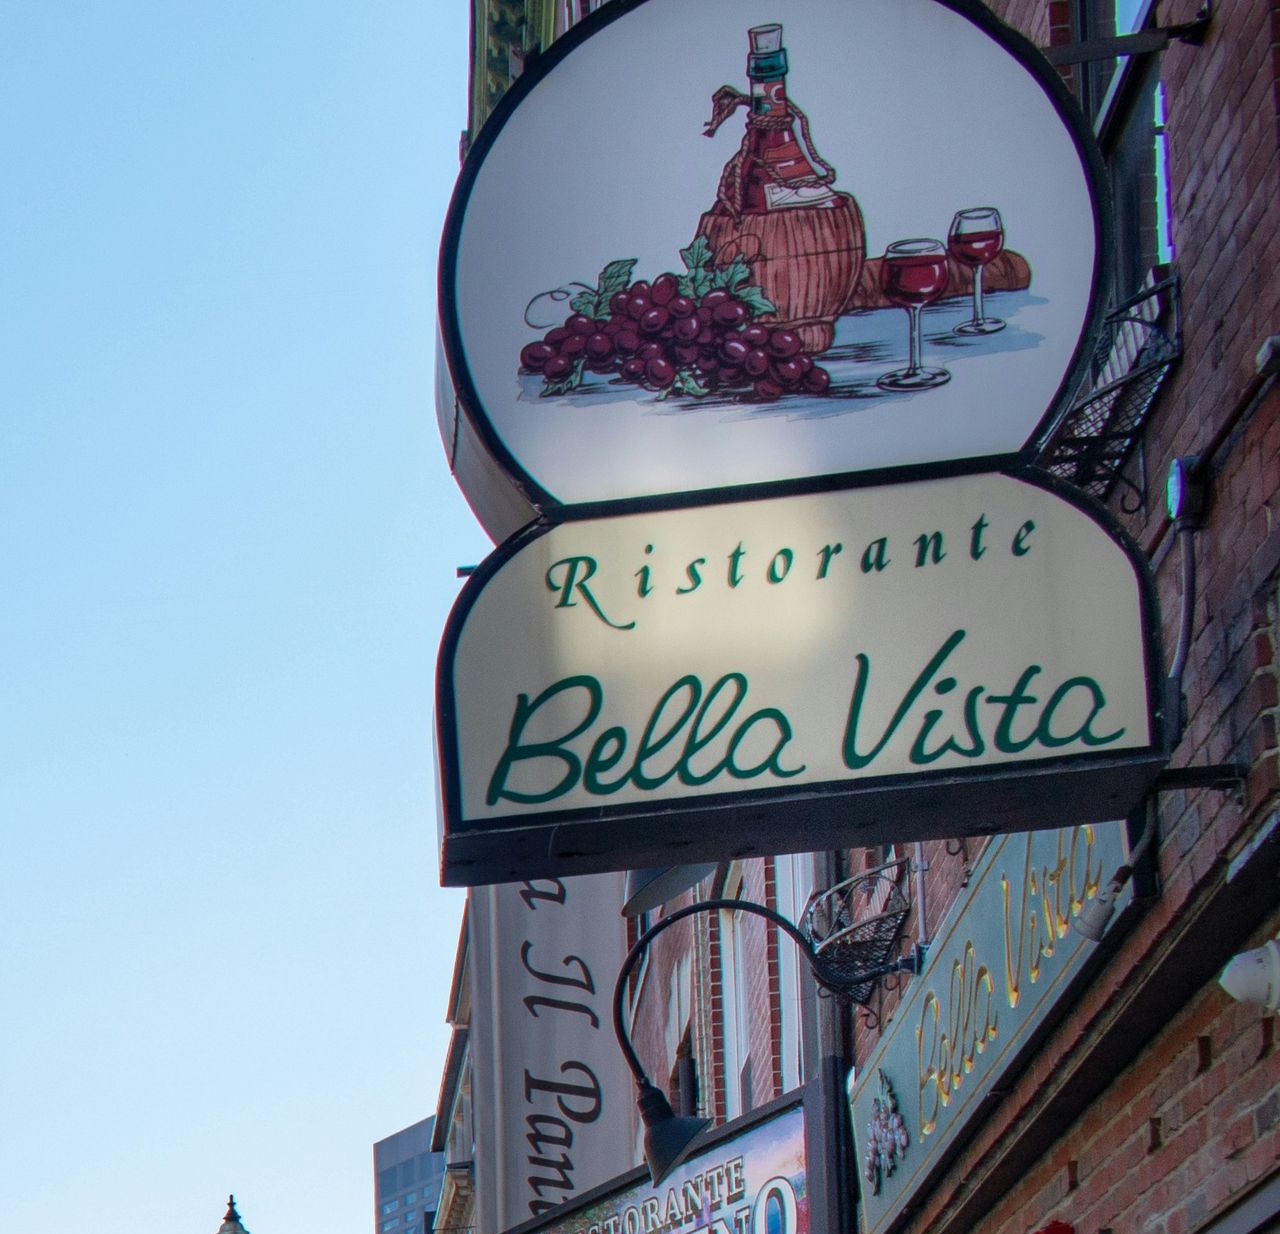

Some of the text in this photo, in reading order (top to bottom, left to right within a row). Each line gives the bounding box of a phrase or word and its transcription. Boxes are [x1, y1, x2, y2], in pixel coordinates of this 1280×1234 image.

[546, 514, 1036, 631] Ristorante
[486, 629, 1126, 806] Bella Vista
[915, 939, 999, 1144] Bella
